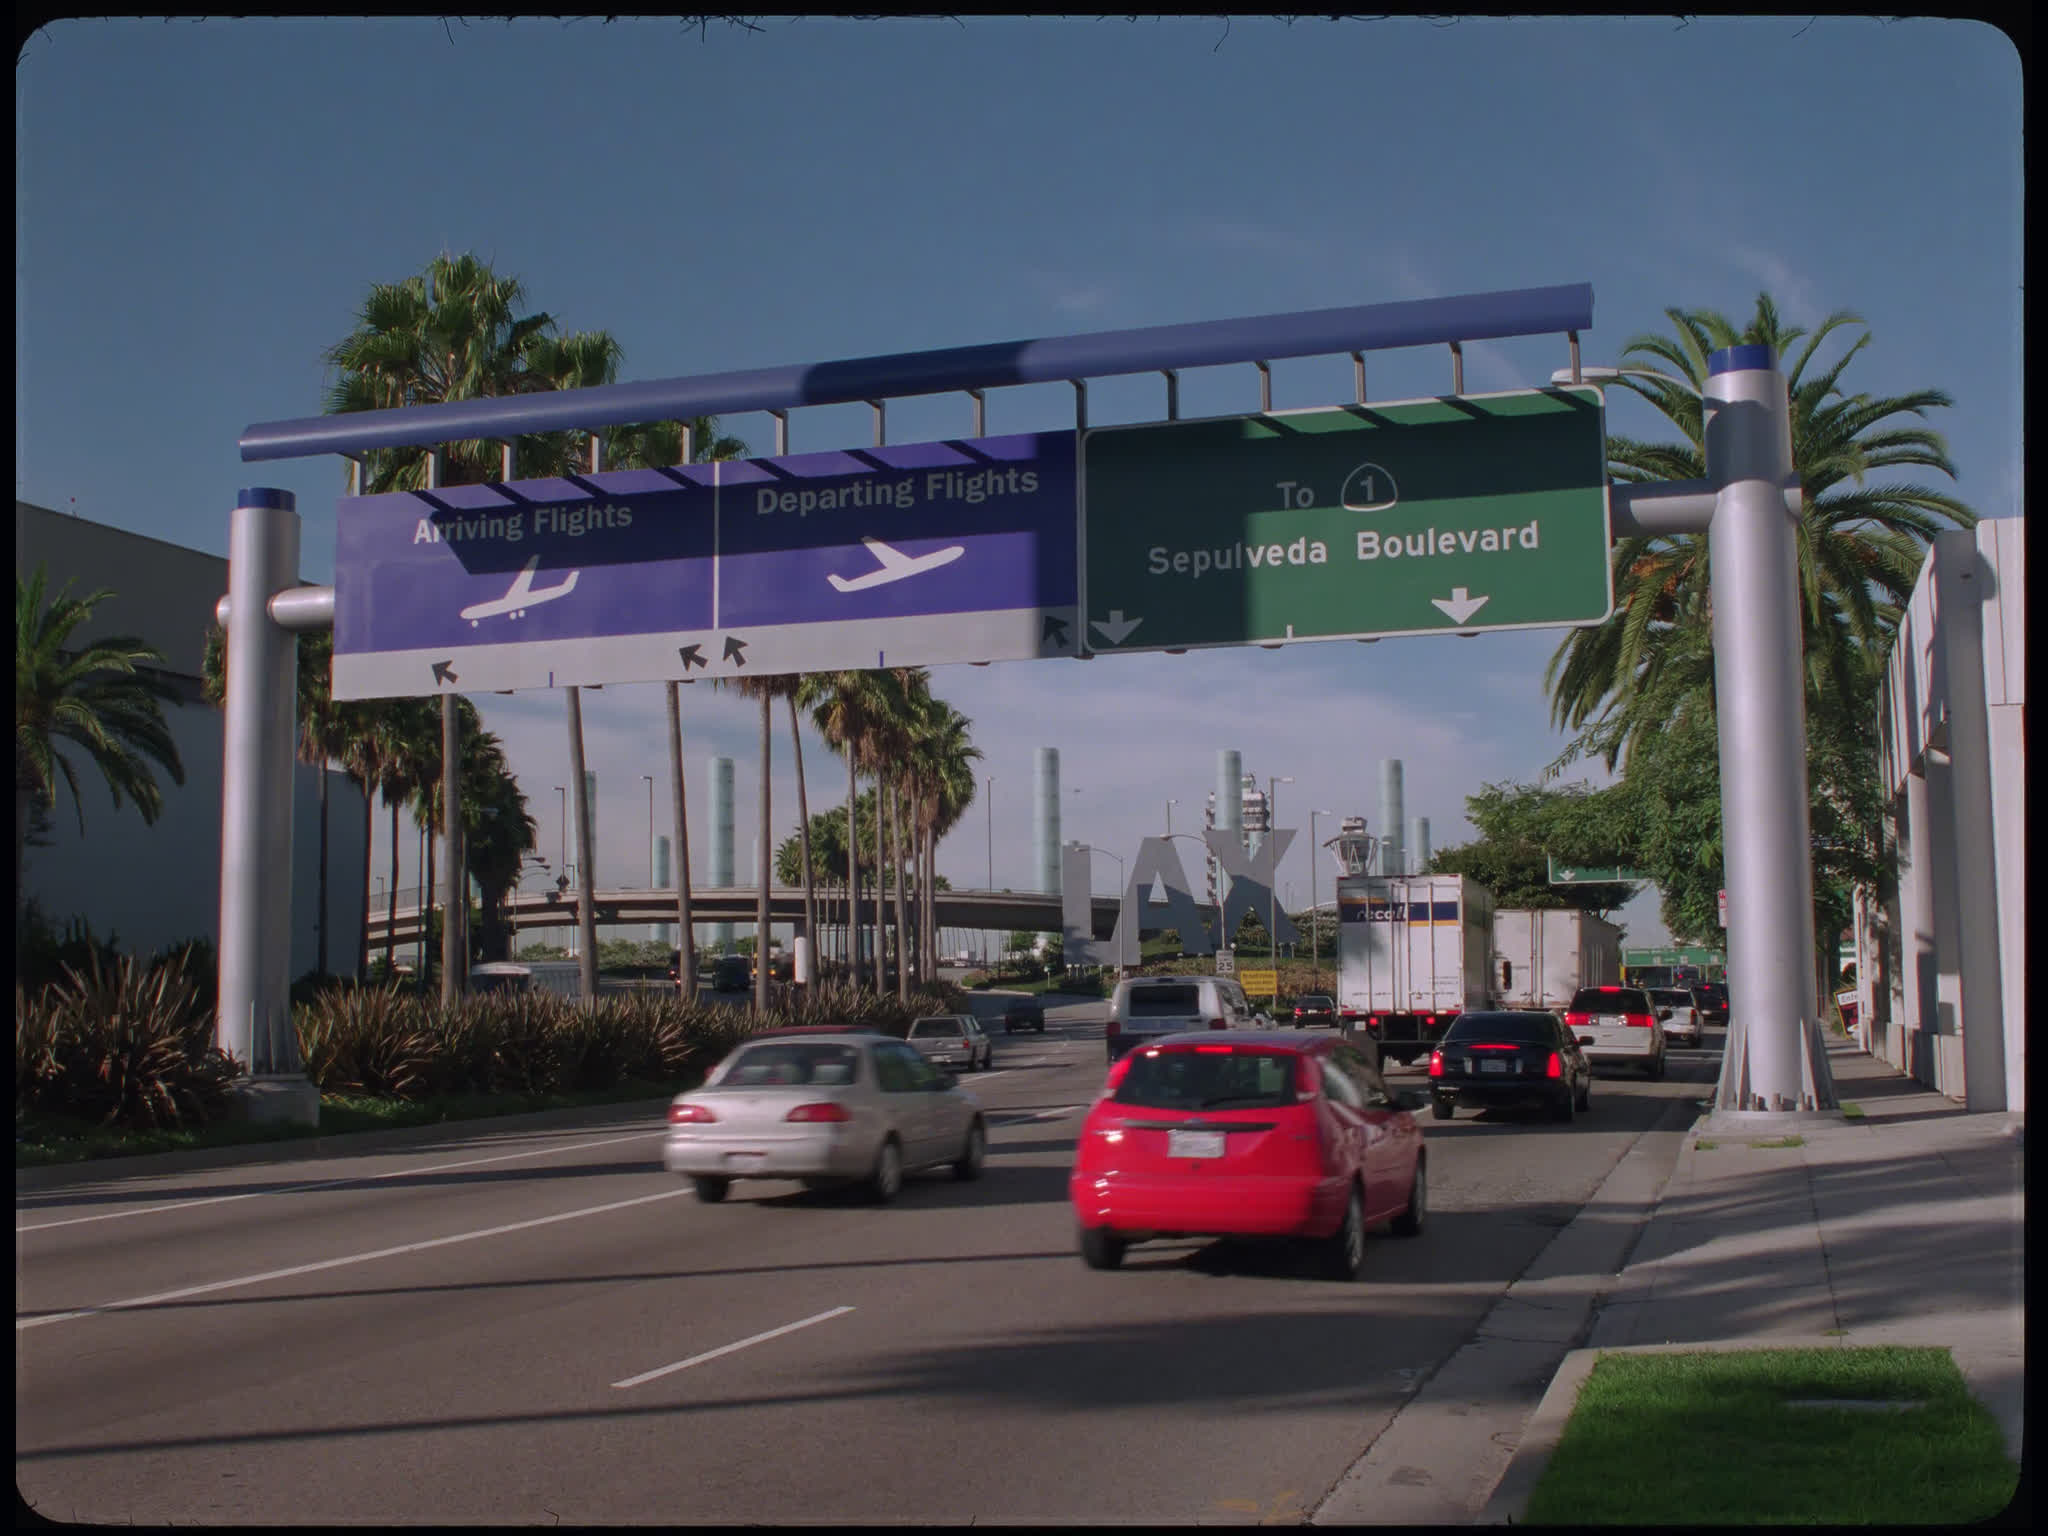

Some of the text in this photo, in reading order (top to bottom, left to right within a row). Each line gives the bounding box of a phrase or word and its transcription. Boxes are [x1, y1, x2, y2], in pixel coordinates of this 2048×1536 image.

[756, 465, 1040, 516] Departing Flights
[1276, 475, 1375, 509] To 1
[414, 503, 633, 545] Arriving Flights
[1149, 520, 1539, 577] Sepulveda Boulevard
[1062, 829, 1298, 966] LAX
[1218, 961, 1233, 971] 25
